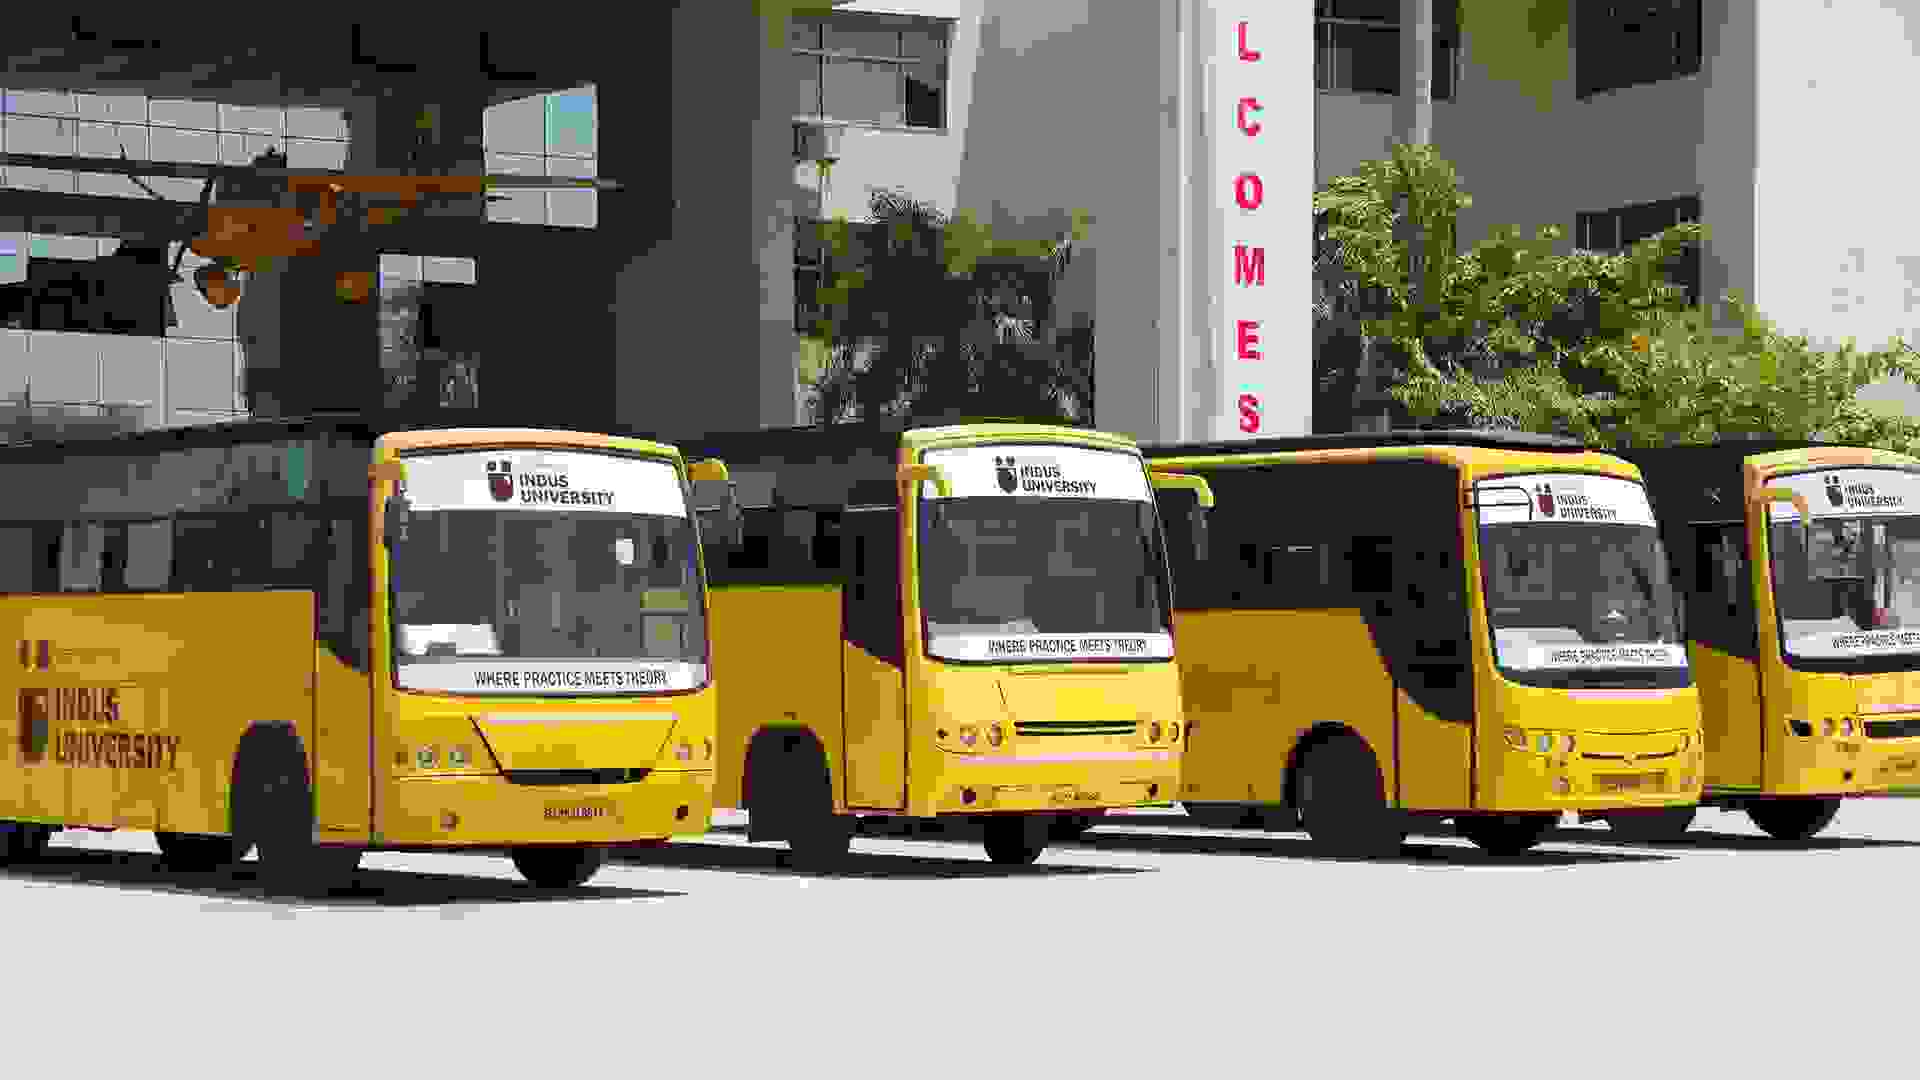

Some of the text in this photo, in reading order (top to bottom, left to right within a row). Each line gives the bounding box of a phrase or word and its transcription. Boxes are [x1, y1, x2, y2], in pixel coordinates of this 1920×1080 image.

[1020, 465, 1062, 478] INDUS
[519, 472, 569, 488] INDUS
[1022, 480, 1097, 495] UNIVERSITY
[520, 489, 615, 504] UNIVERSITY
[474, 671, 520, 689] WHERE
[524, 671, 583, 687] PRACTICE
[584, 671, 624, 687] MEETS
[56, 688, 121, 722] INDUS
[56, 730, 183, 770] UNIVERSITY
